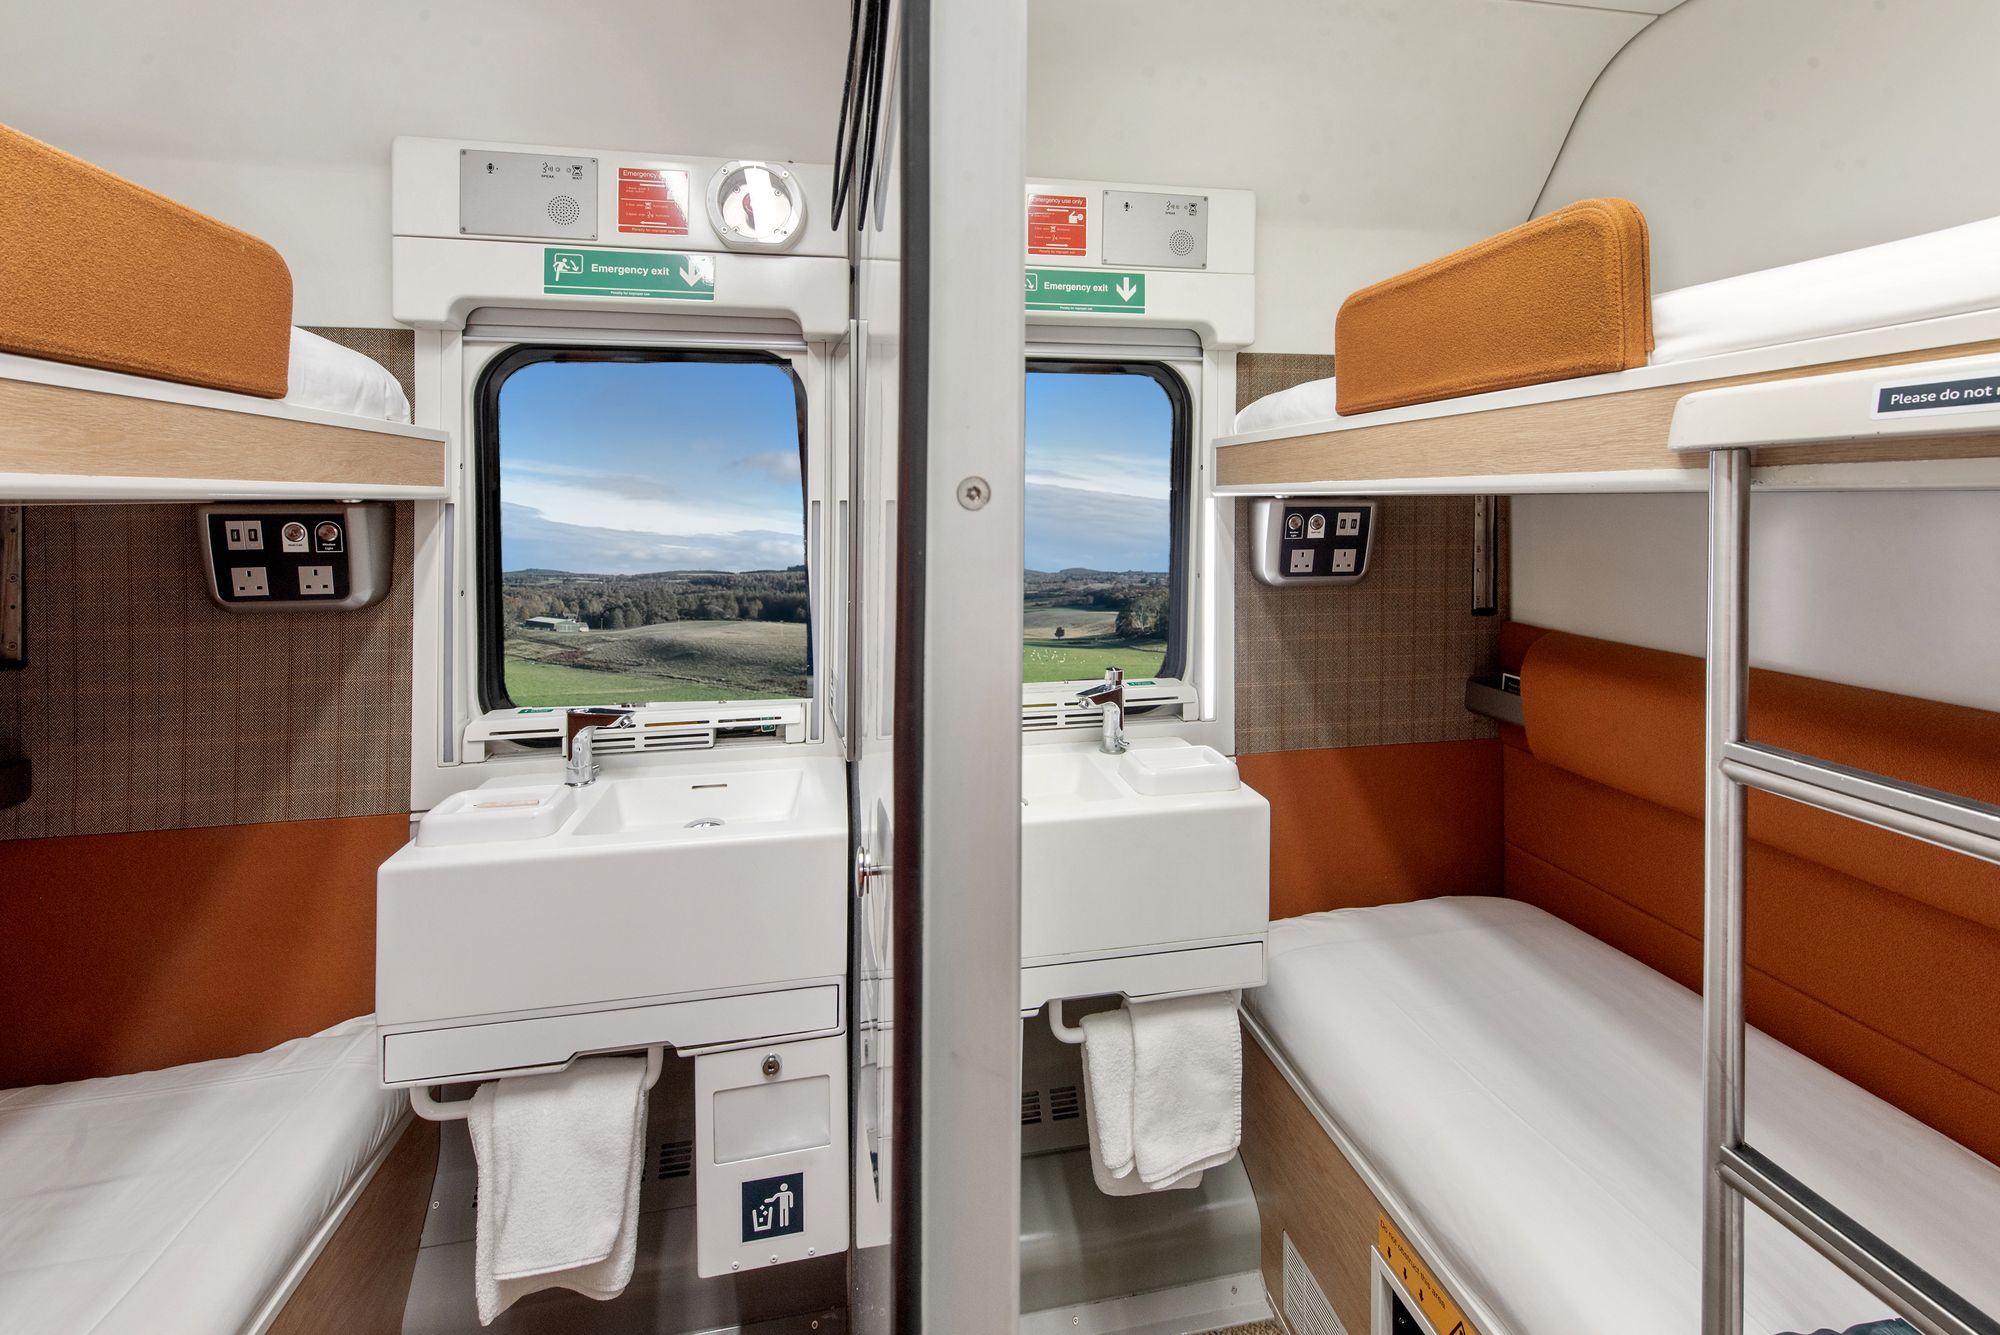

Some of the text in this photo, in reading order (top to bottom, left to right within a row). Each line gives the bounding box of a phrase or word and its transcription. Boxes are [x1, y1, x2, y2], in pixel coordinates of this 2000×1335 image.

[623, 169, 657, 179] Emergency
[591, 263, 670, 277] Emergency exit
[1043, 281, 1109, 293] Emergency exit
[1890, 392, 1937, 405] Please
[1939, 388, 1960, 401] do
[1963, 385, 1993, 399] not
